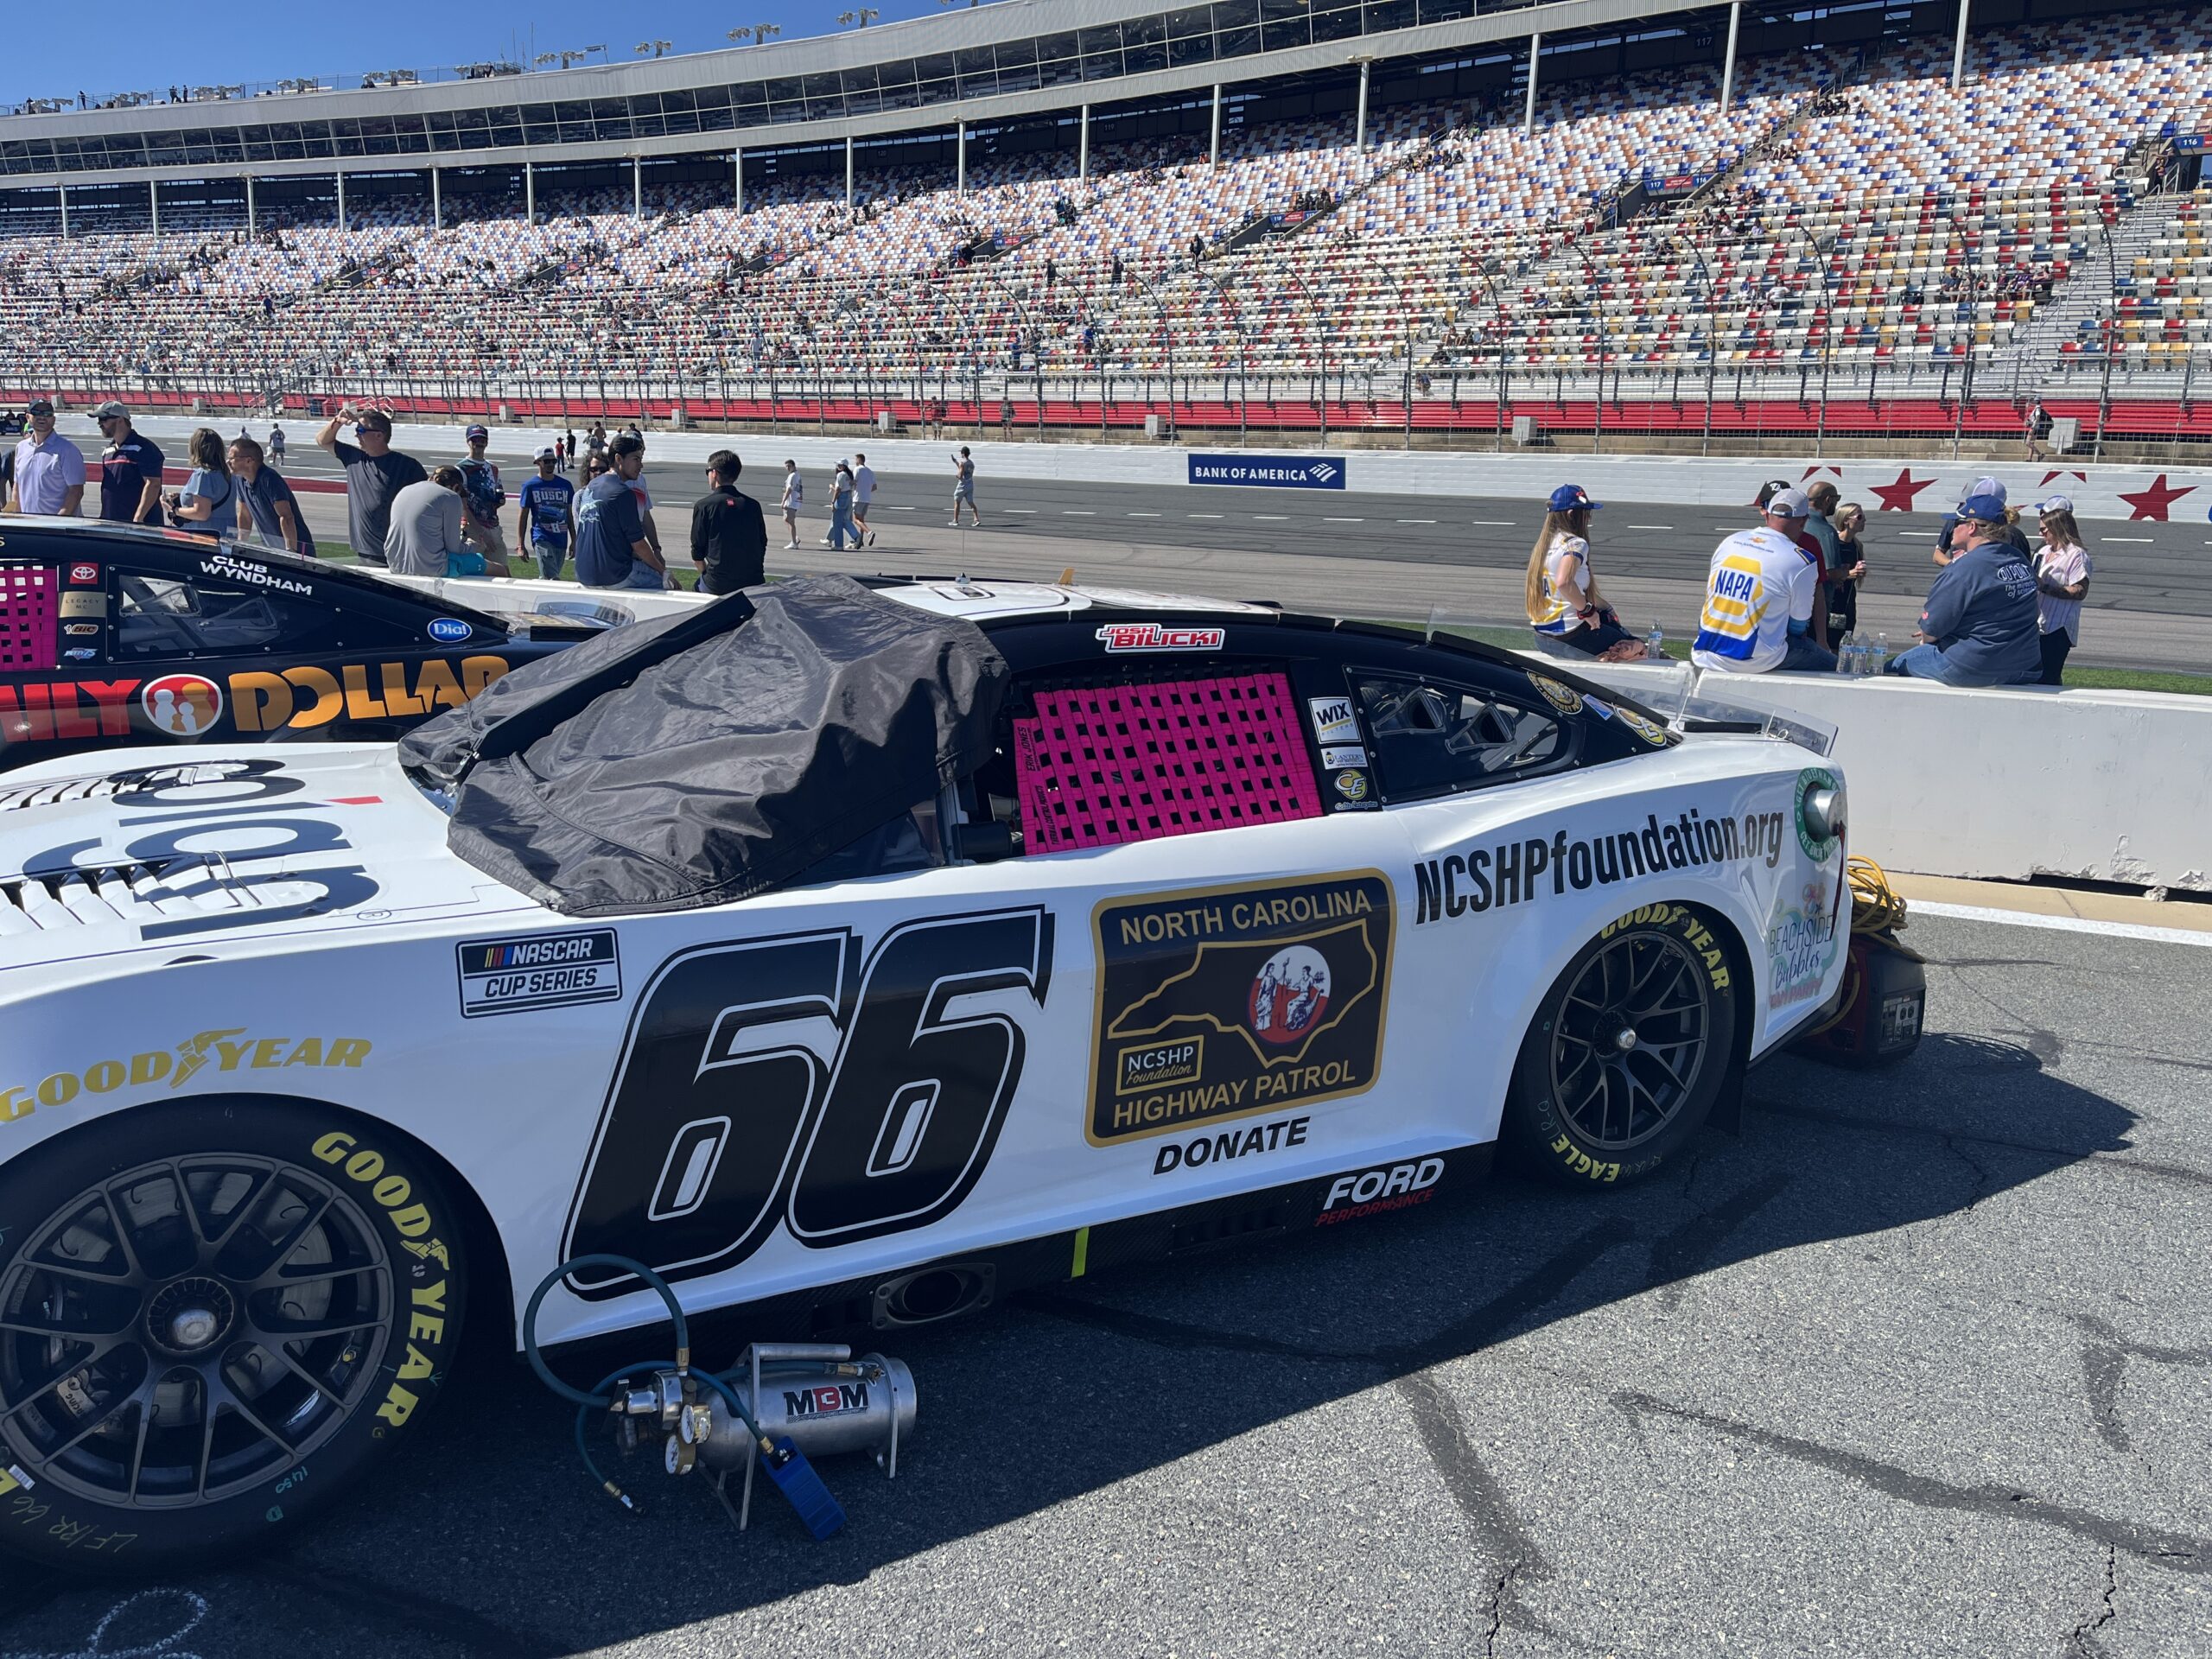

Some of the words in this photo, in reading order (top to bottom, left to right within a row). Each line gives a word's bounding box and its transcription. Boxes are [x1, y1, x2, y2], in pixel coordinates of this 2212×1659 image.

[1696, 36, 1712, 47] 117
[1195, 467, 1228, 478] BANK
[1230, 467, 1246, 479] OF
[1249, 468, 1306, 481] AMERICA
[532, 490, 568, 503] BUSCH
[200, 562, 312, 595] WYNDHAM
[213, 556, 268, 574] CLUB
[1715, 569, 1754, 601] NAPA
[2005, 583, 2016, 592] The
[2007, 588, 2016, 598] of
[434, 623, 467, 635] Dial
[1104, 627, 1154, 636] JOSH
[1114, 632, 1218, 646] BILICKI
[1316, 702, 1350, 726] WIX
[1018, 727, 1032, 752] JONES
[1025, 752, 1036, 772] ERIK
[1415, 808, 1784, 925] NCSHPfoundation.org
[1120, 907, 1224, 945] NORTH
[1230, 889, 1372, 930] CAROLINA
[512, 938, 593, 965] NASCAR
[1770, 914, 1834, 958] BEACHSIDE
[485, 975, 526, 998] CUP
[529, 967, 598, 993] SERIES
[1776, 948, 1820, 989] Bubbles
[1128, 1046, 1194, 1071] NCSHP
[0, 1036, 373, 1122] GOODYEAR
[1126, 1064, 1192, 1085] Foundation
[558, 904, 1056, 1303] 66
[1114, 1078, 1249, 1128] HIGHWAY
[1255, 1059, 1356, 1100] PATROL
[1154, 1116, 1310, 1176] DONATE
[1551, 1133, 1621, 1182] EAGLE
[1323, 1158, 1445, 1211] FORD
[1314, 1189, 1434, 1226] PERFORMANCE
[312, 1132, 449, 1427] GOODYEAR
[783, 1382, 869, 1416] MBM
